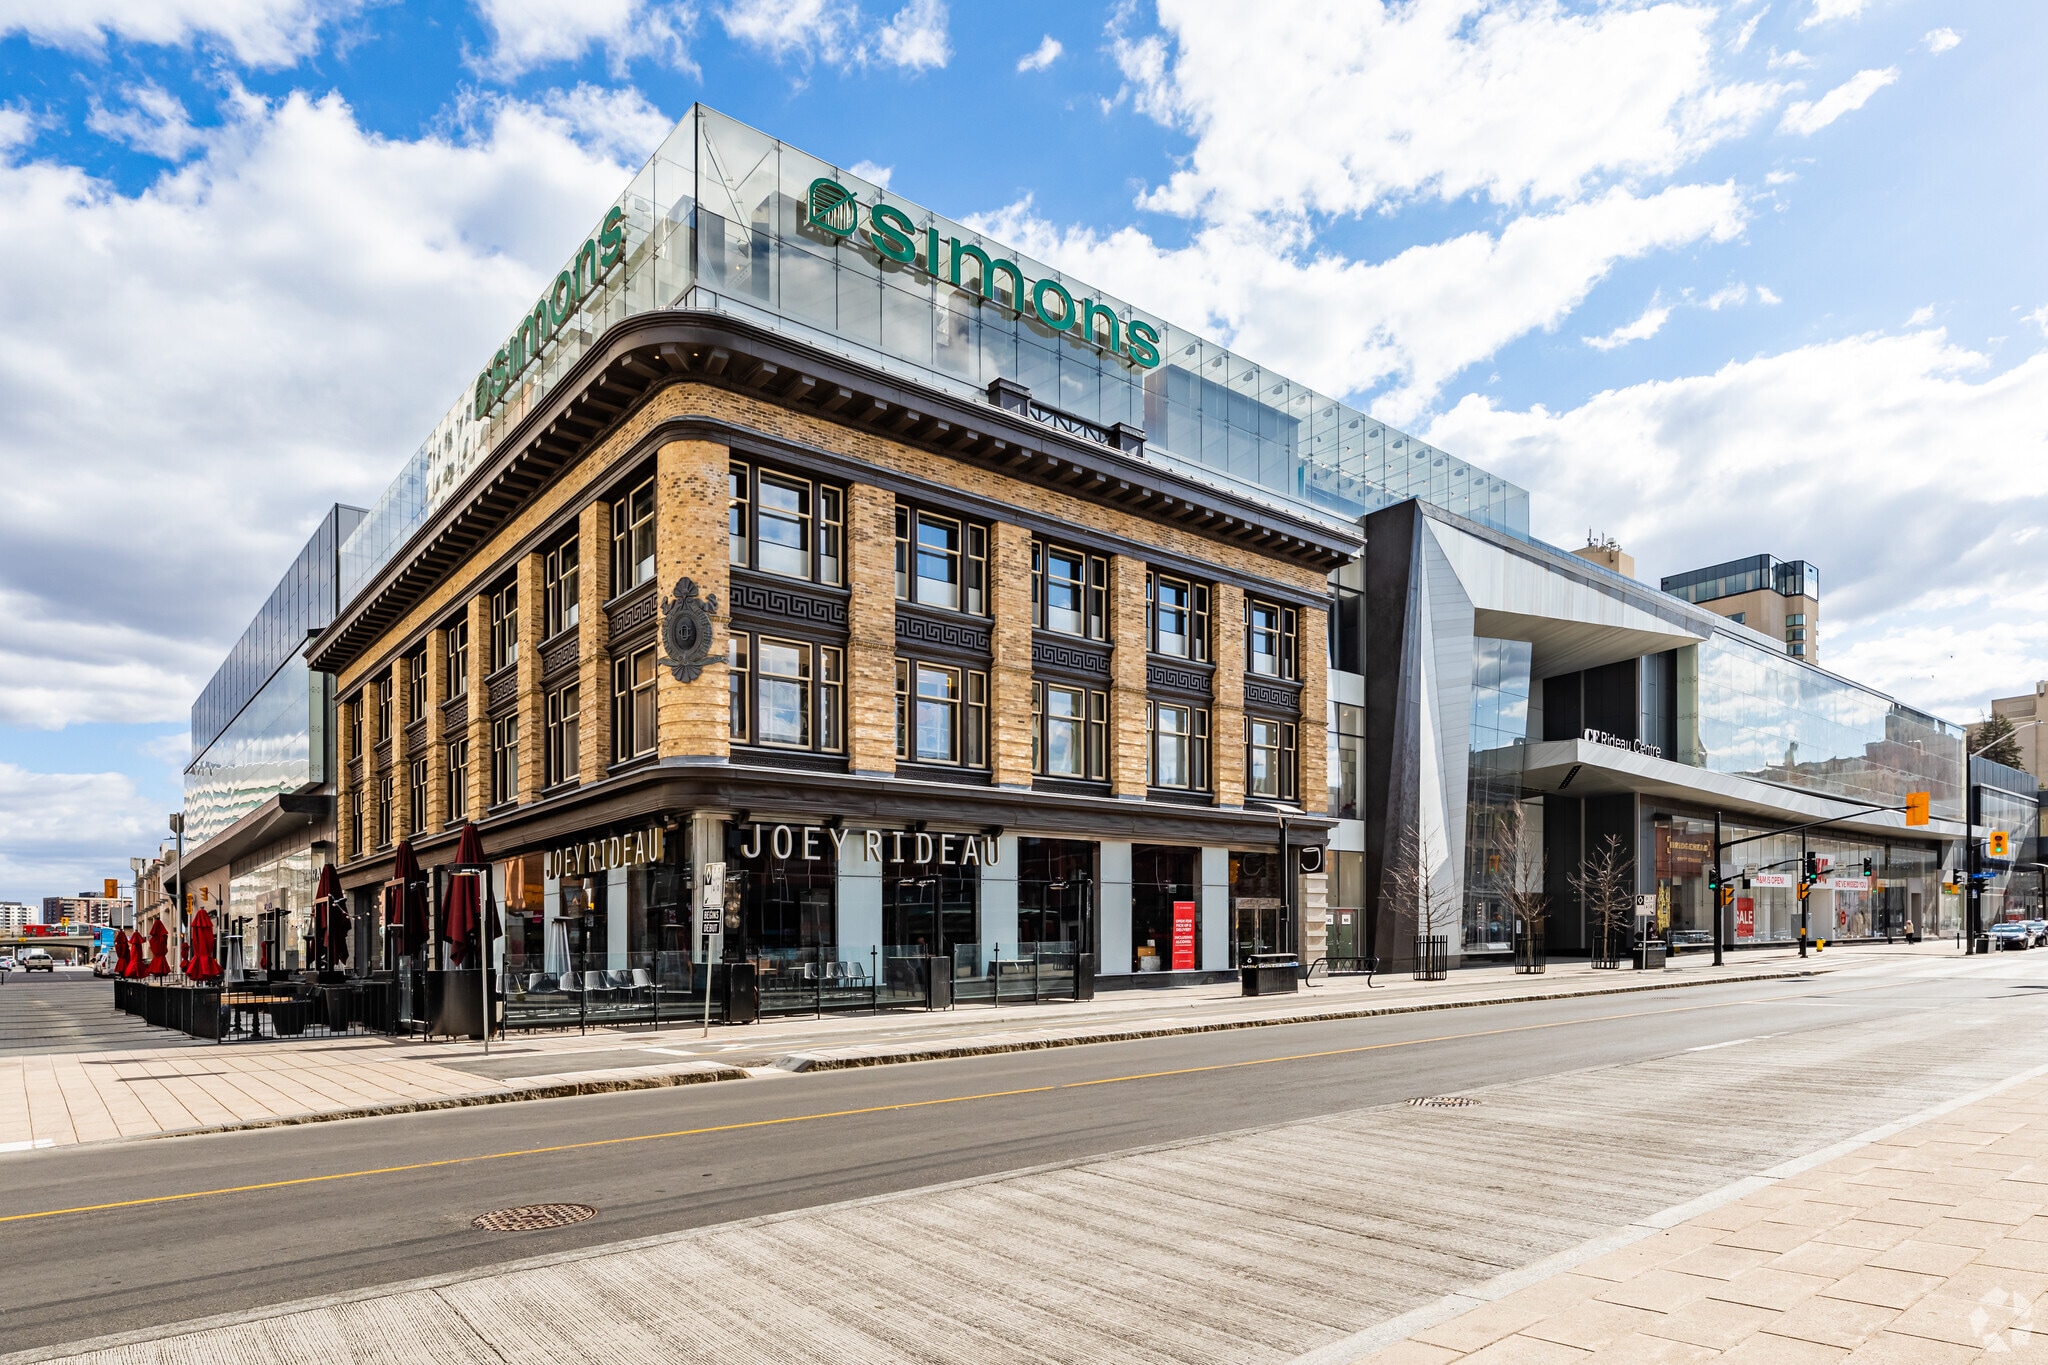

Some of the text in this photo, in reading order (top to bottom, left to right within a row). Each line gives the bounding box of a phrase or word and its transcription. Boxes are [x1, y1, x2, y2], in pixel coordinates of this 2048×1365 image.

[490, 205, 623, 398] simons
[869, 203, 1161, 370] simons
[1601, 731, 1631, 751] Rideau
[1633, 738, 1661, 758] Centre
[545, 827, 661, 880] JOEY RIDEAU
[741, 823, 1000, 867] JOEY RIDEAU
[703, 910, 720, 920] BEGINS
[1736, 910, 1753, 924] SALE
